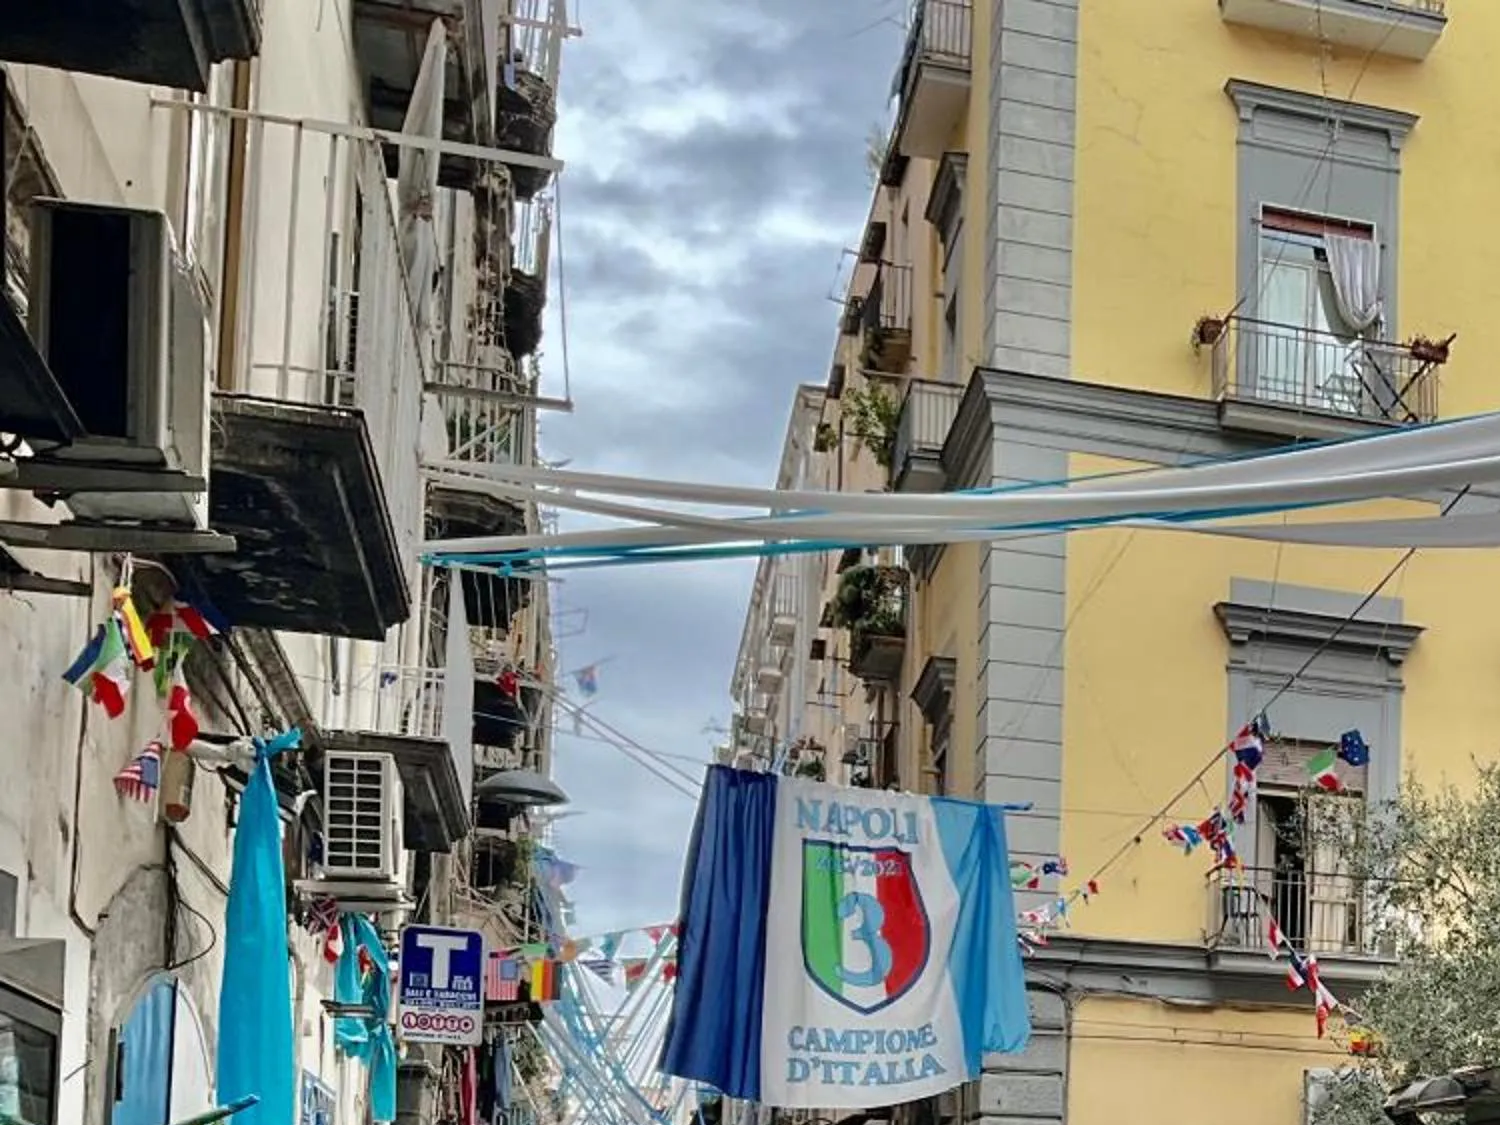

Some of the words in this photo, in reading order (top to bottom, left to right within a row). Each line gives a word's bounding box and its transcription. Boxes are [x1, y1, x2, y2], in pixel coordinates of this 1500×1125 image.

[796, 797, 920, 844] NAPOLI
[835, 891, 893, 987] 3
[416, 934, 468, 988] T
[402, 1011, 474, 1033] LOTTO
[787, 1023, 938, 1055] CAMPIONE
[786, 1053, 947, 1086] D'ITALIA
